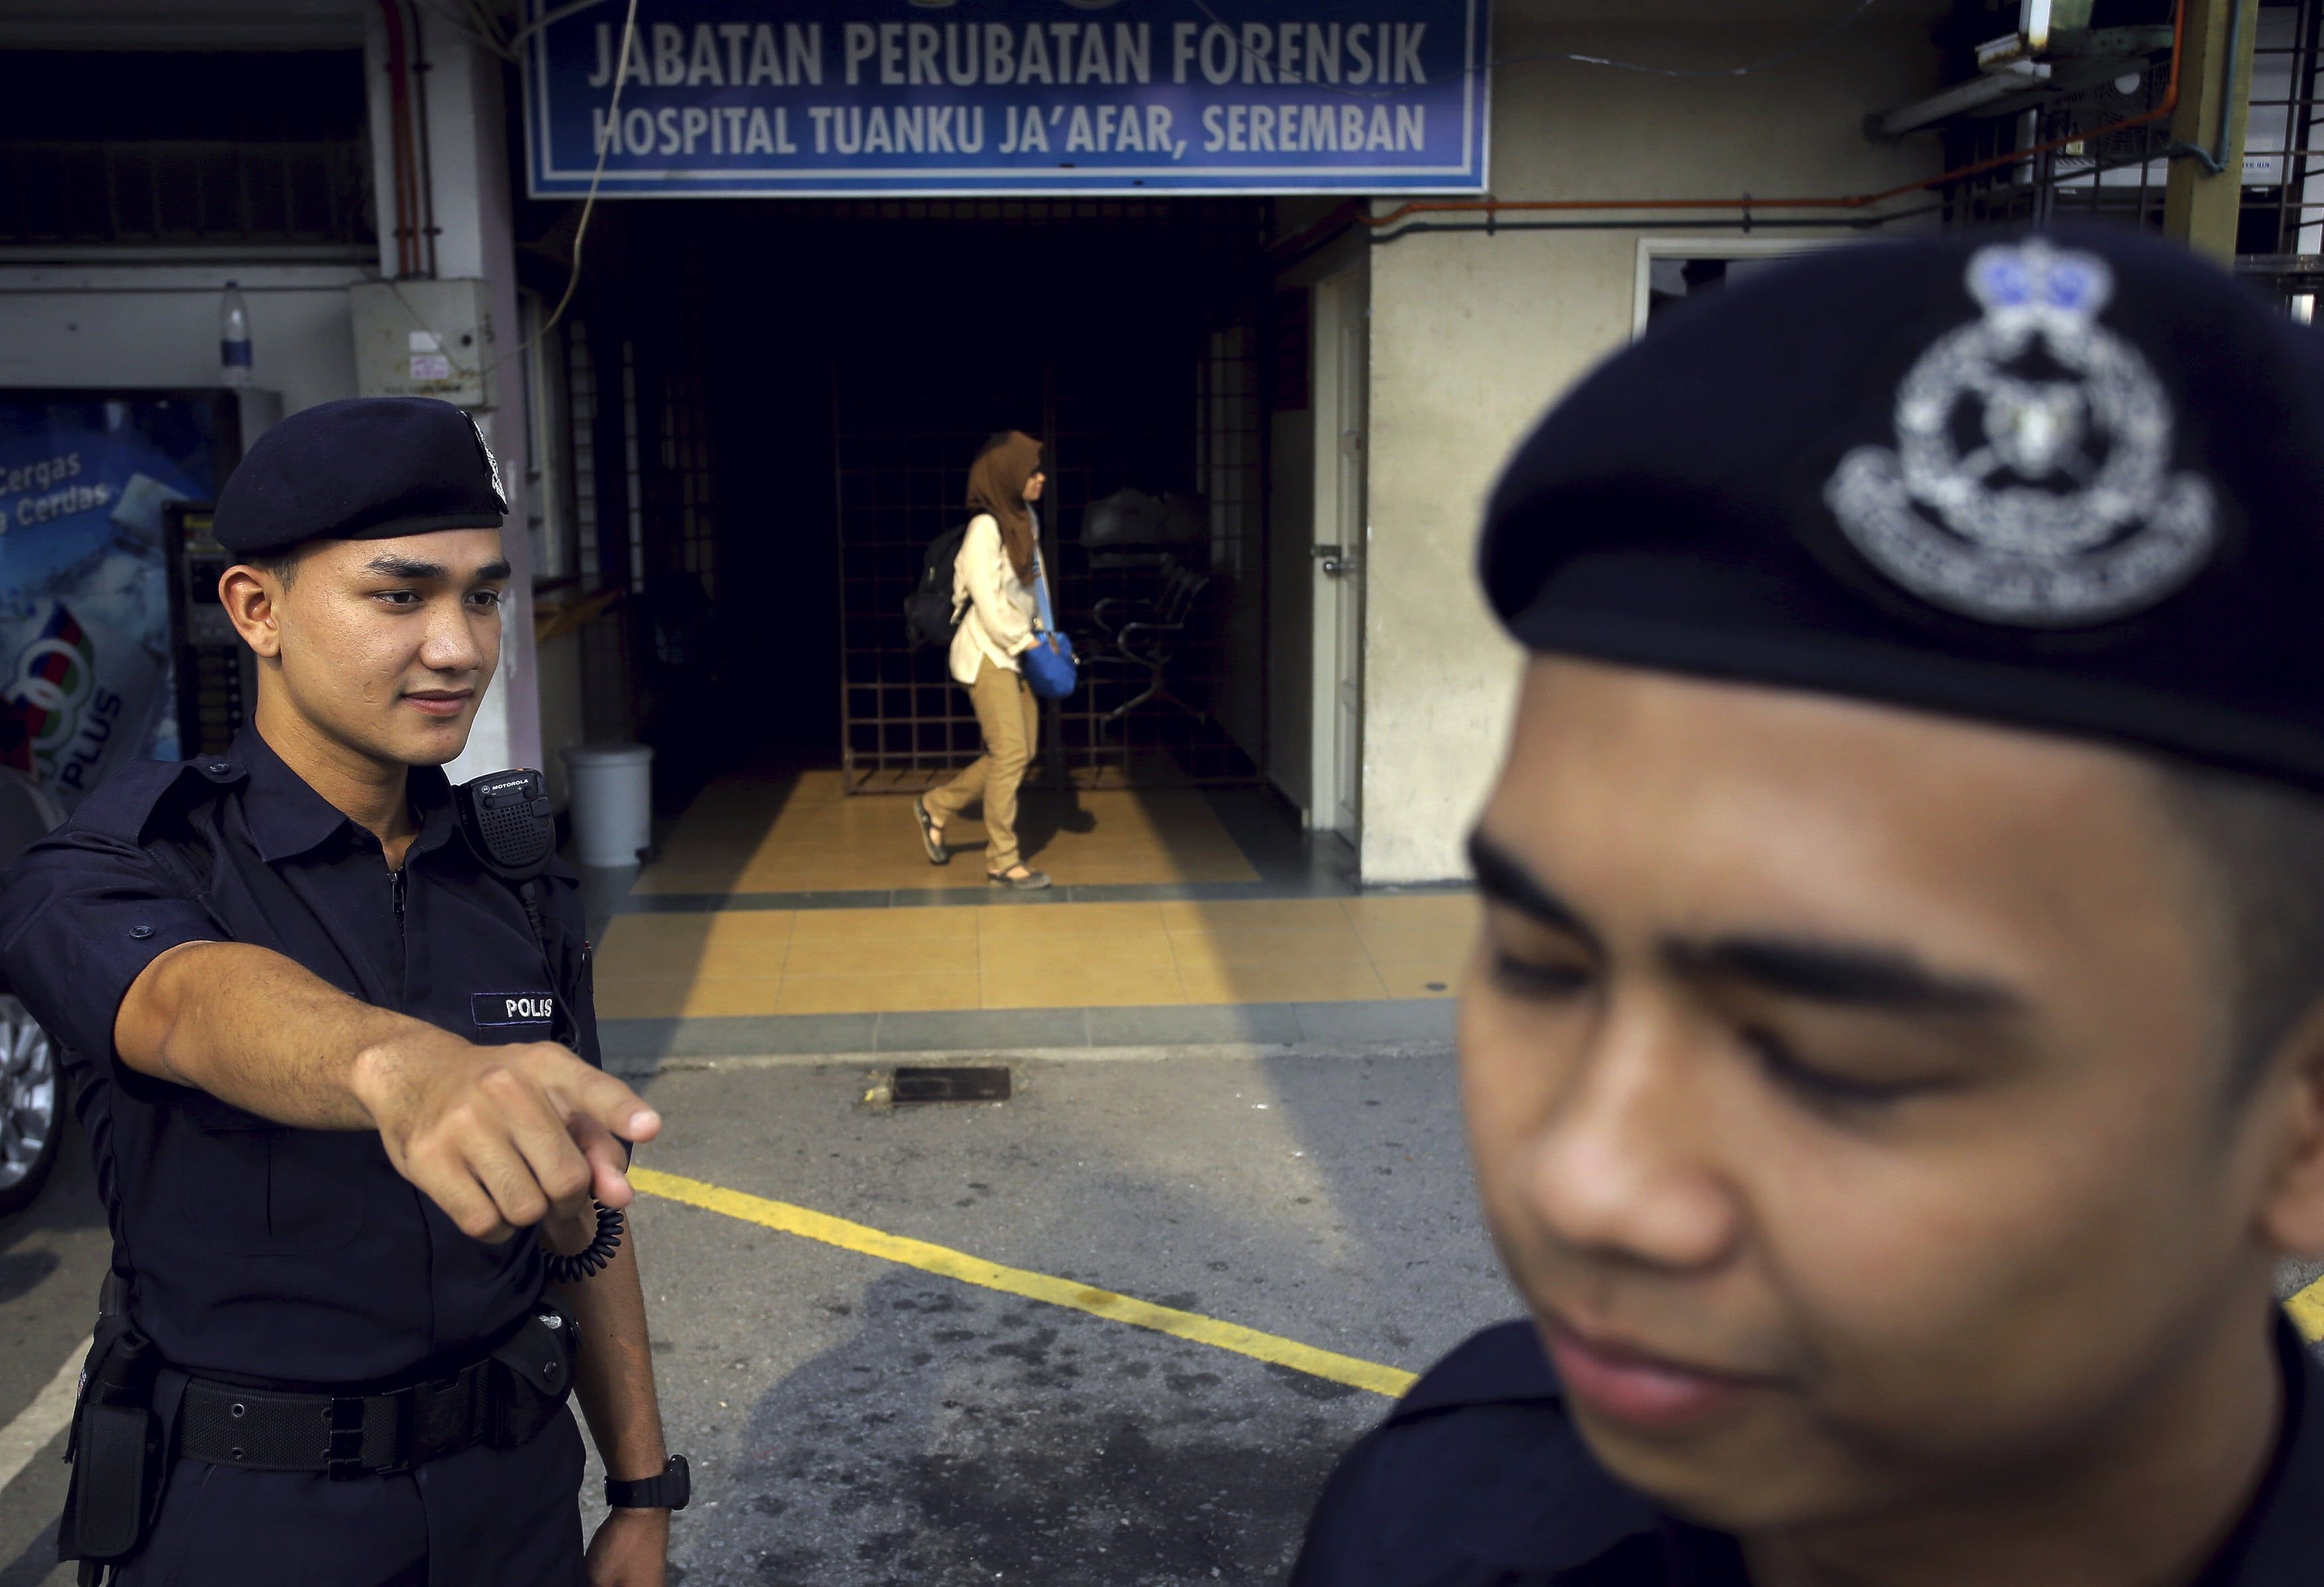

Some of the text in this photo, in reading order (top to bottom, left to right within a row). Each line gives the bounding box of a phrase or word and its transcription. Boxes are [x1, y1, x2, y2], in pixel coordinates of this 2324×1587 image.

[589, 22, 1427, 87] JABATAN PERUBATAN FORENSIK
[592, 106, 795, 155] HOSPITAL
[807, 106, 985, 154] TUANKU
[1203, 104, 1425, 153] SEREMBAN
[61, 687, 122, 790] PLUS
[492, 778, 529, 791] MOTOROLA
[505, 998, 552, 1018] POLIS
